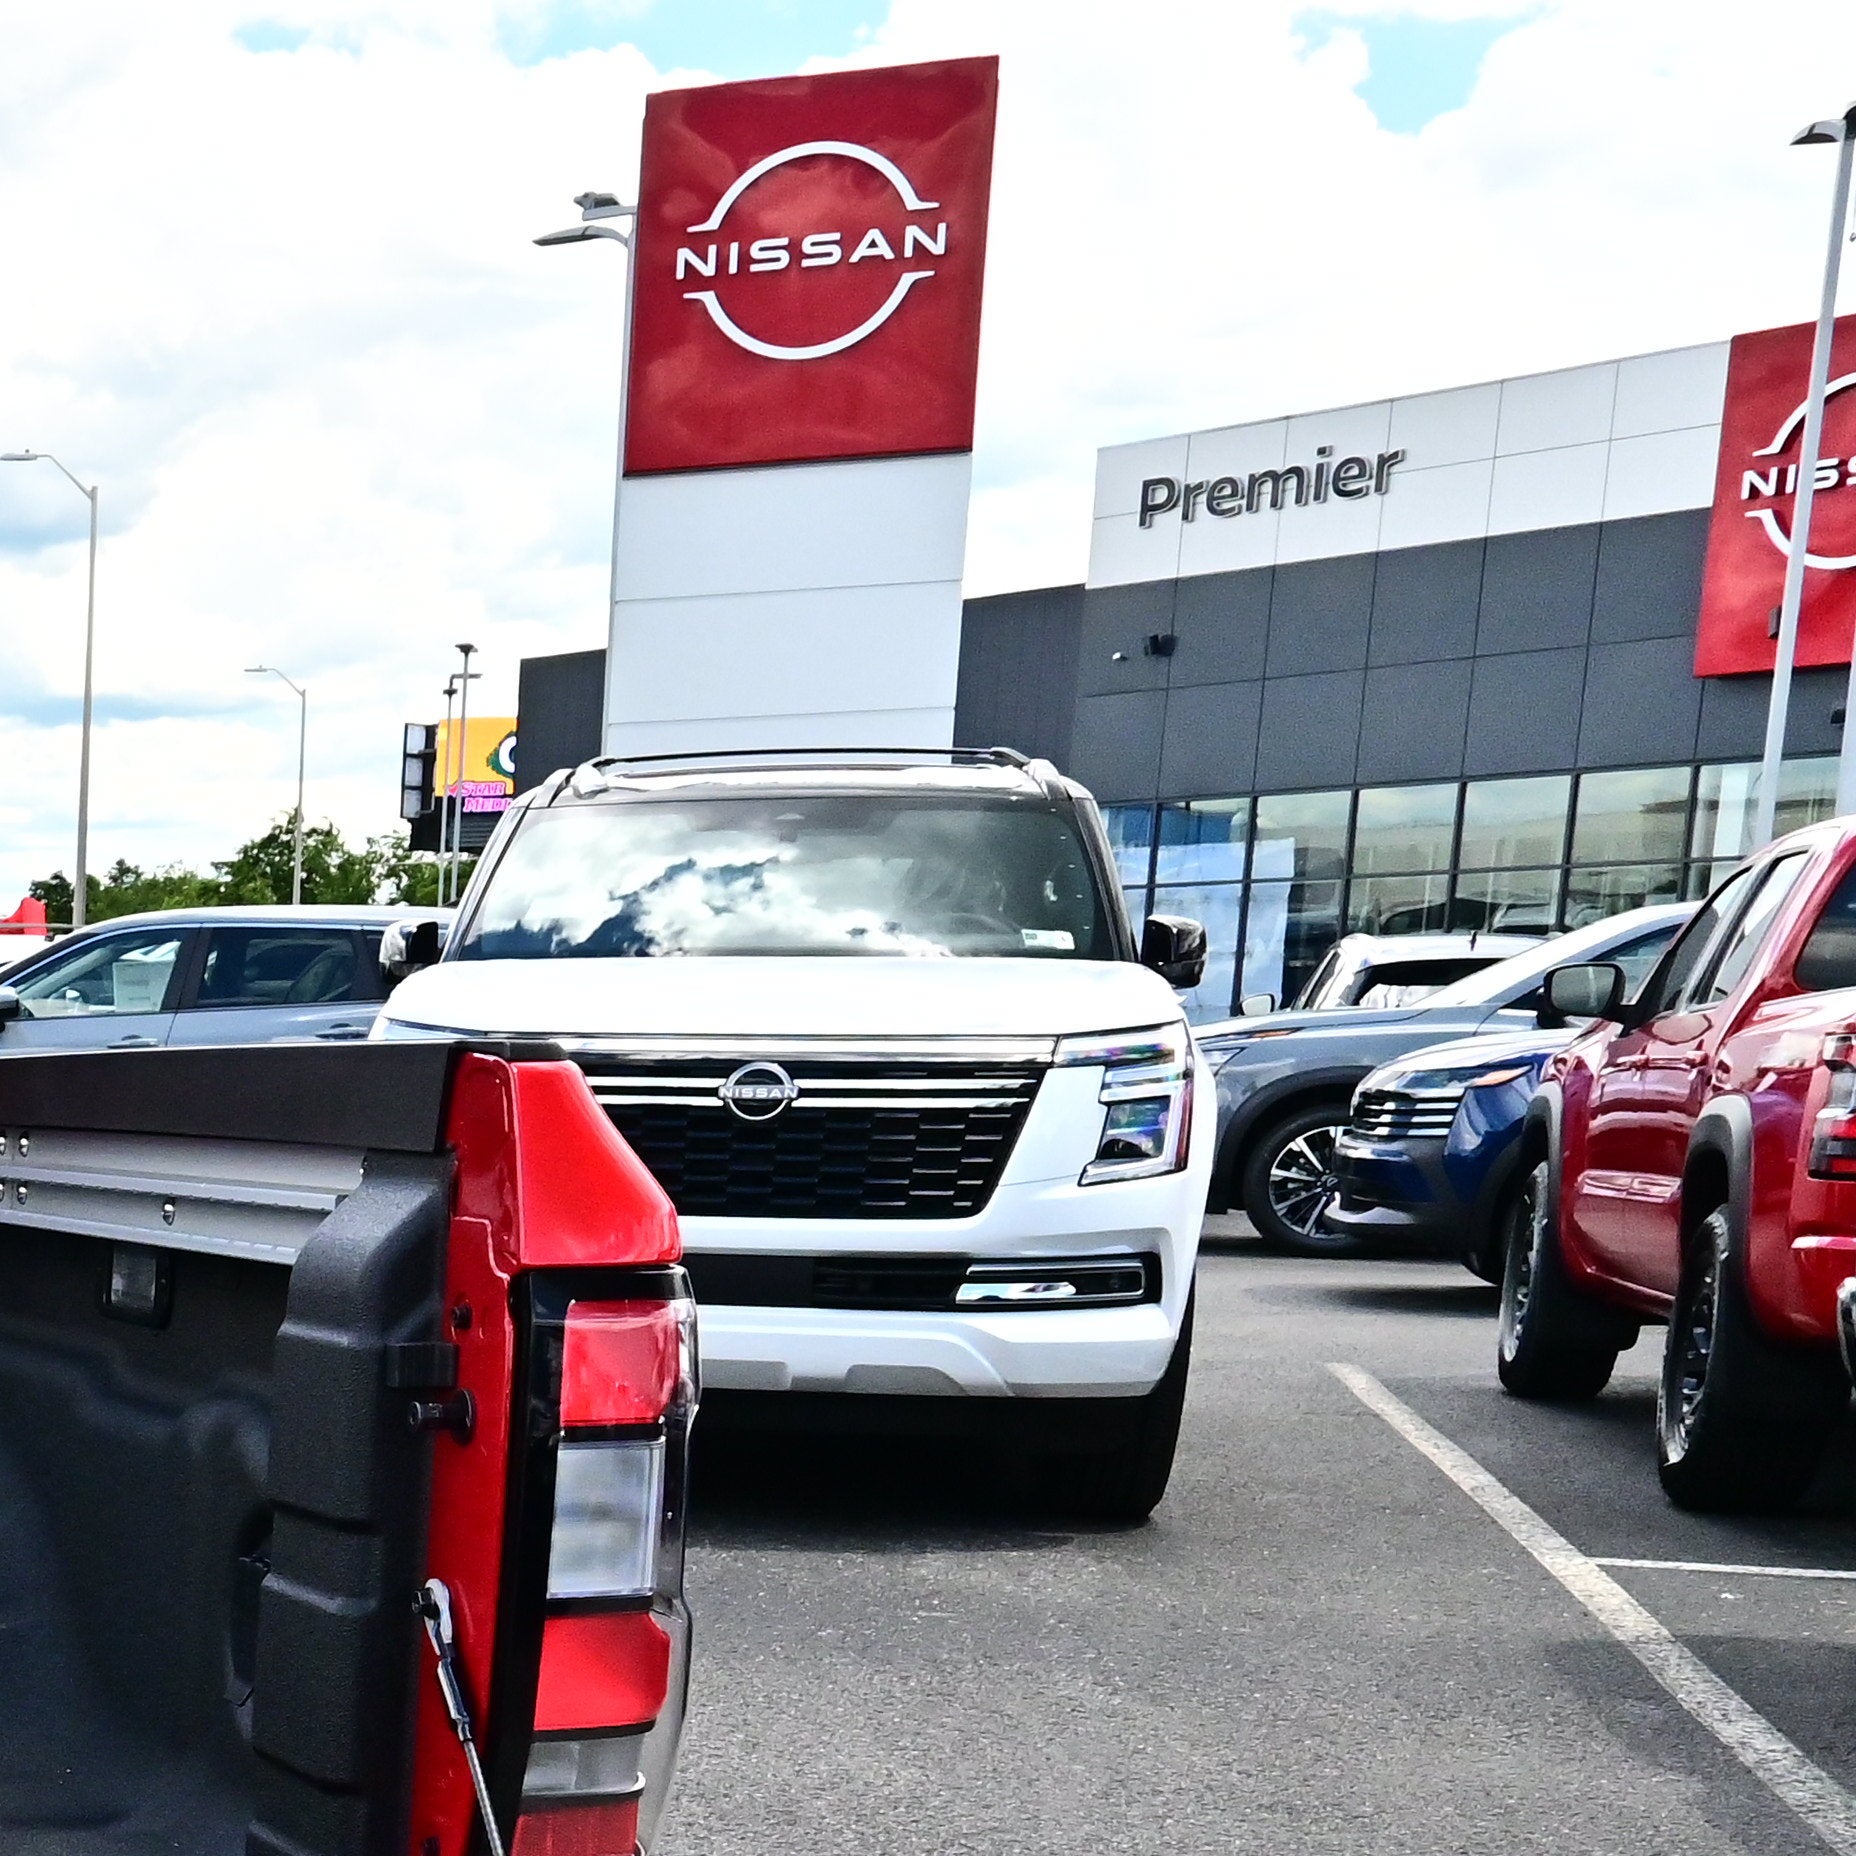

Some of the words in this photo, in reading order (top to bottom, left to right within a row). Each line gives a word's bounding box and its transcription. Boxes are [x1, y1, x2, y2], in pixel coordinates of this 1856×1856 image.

[676, 222, 948, 281] NISSAN
[1138, 445, 1406, 528] Premier
[719, 1087, 798, 1098] NISSAN
